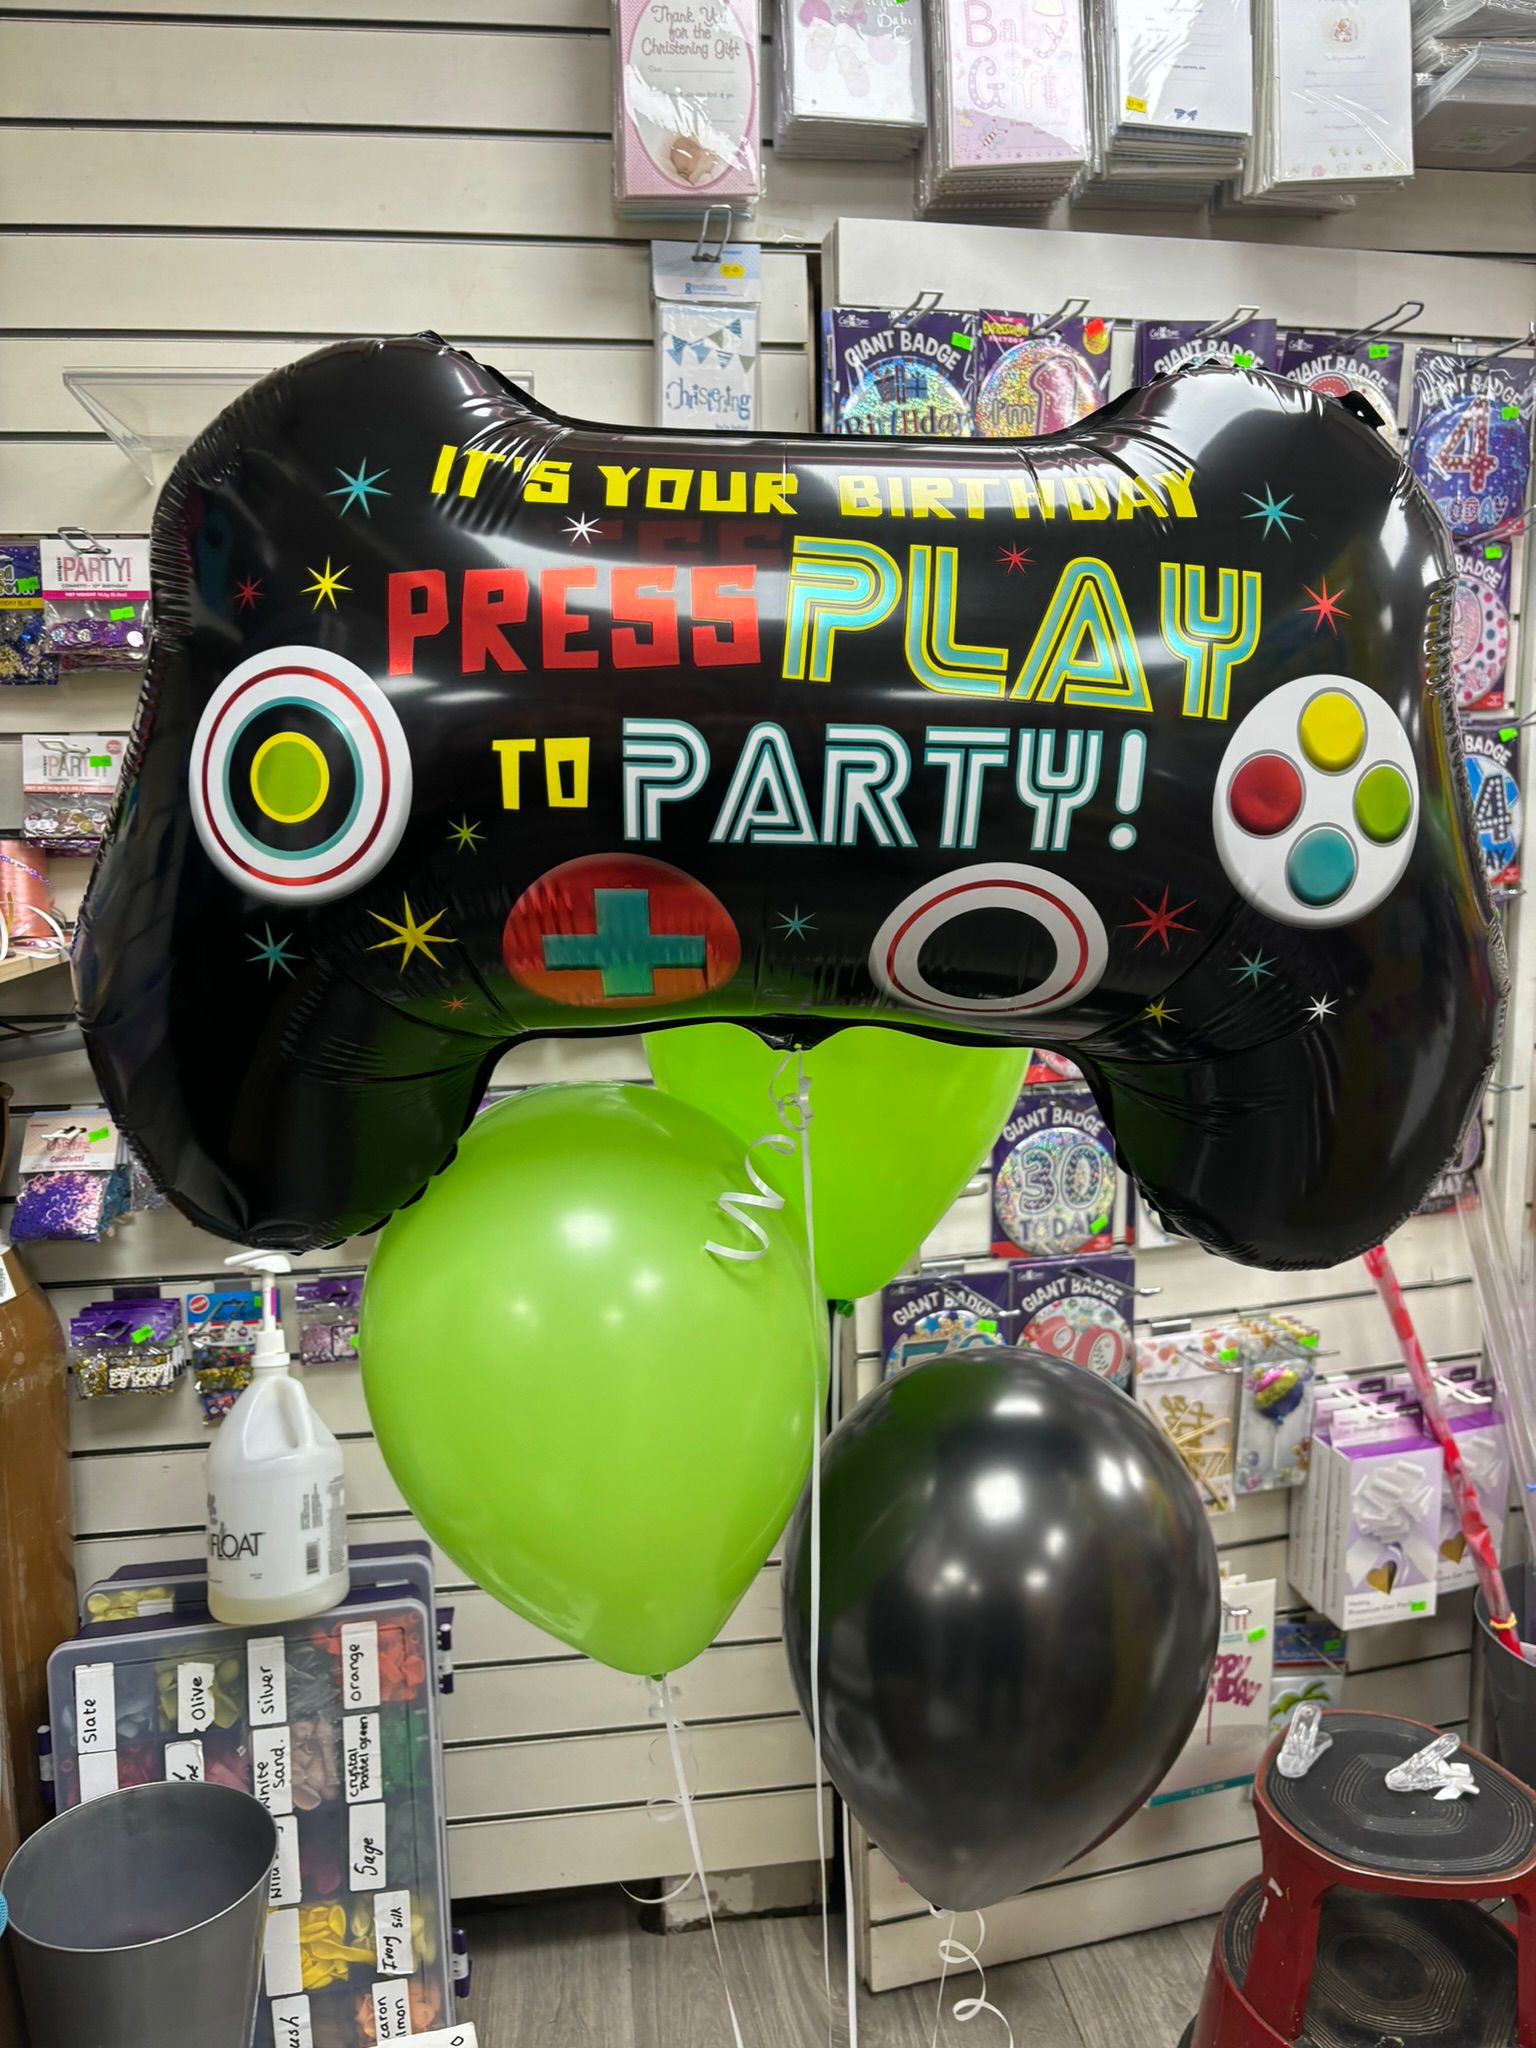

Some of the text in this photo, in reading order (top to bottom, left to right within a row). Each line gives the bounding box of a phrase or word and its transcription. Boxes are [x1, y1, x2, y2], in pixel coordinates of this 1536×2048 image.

[651, 5, 695, 23] Thank
[668, 22, 712, 41] for the
[641, 37, 741, 60] Christening Gift
[968, 55, 1058, 110] Gift
[844, 330, 962, 371] GIANT BADGE
[1153, 338, 1203, 374] GIANT
[1286, 354, 1389, 390] GIANT BADGE
[991, 398, 1034, 425] I'm
[1434, 396, 1499, 494] 4
[430, 444, 1198, 522] IT'S YOUR BIRTHDAY
[63, 556, 131, 581] PARTY!
[387, 534, 1262, 722] PRESS PLAY
[1464, 734, 1512, 768] BADGE
[491, 716, 1148, 852] TO PARTY!
[1475, 773, 1512, 843] 4
[1002, 1106, 1104, 1142] GIANT BADGE
[1018, 1143, 1102, 1215] 30
[892, 1292, 941, 1327] GIANT
[1021, 1278, 1067, 1313] GIANT
[210, 1531, 266, 1559] FLOAT
[191, 1676, 206, 1721] Olive
[257, 1665, 274, 1715] Silver
[82, 1699, 98, 1744] Slate
[354, 1837, 384, 1876] Sage
[382, 1935, 404, 1971] Ivory
[279, 2014, 300, 2048] ush
[377, 1996, 389, 2038] caron
[394, 1998, 406, 2038] lmon
